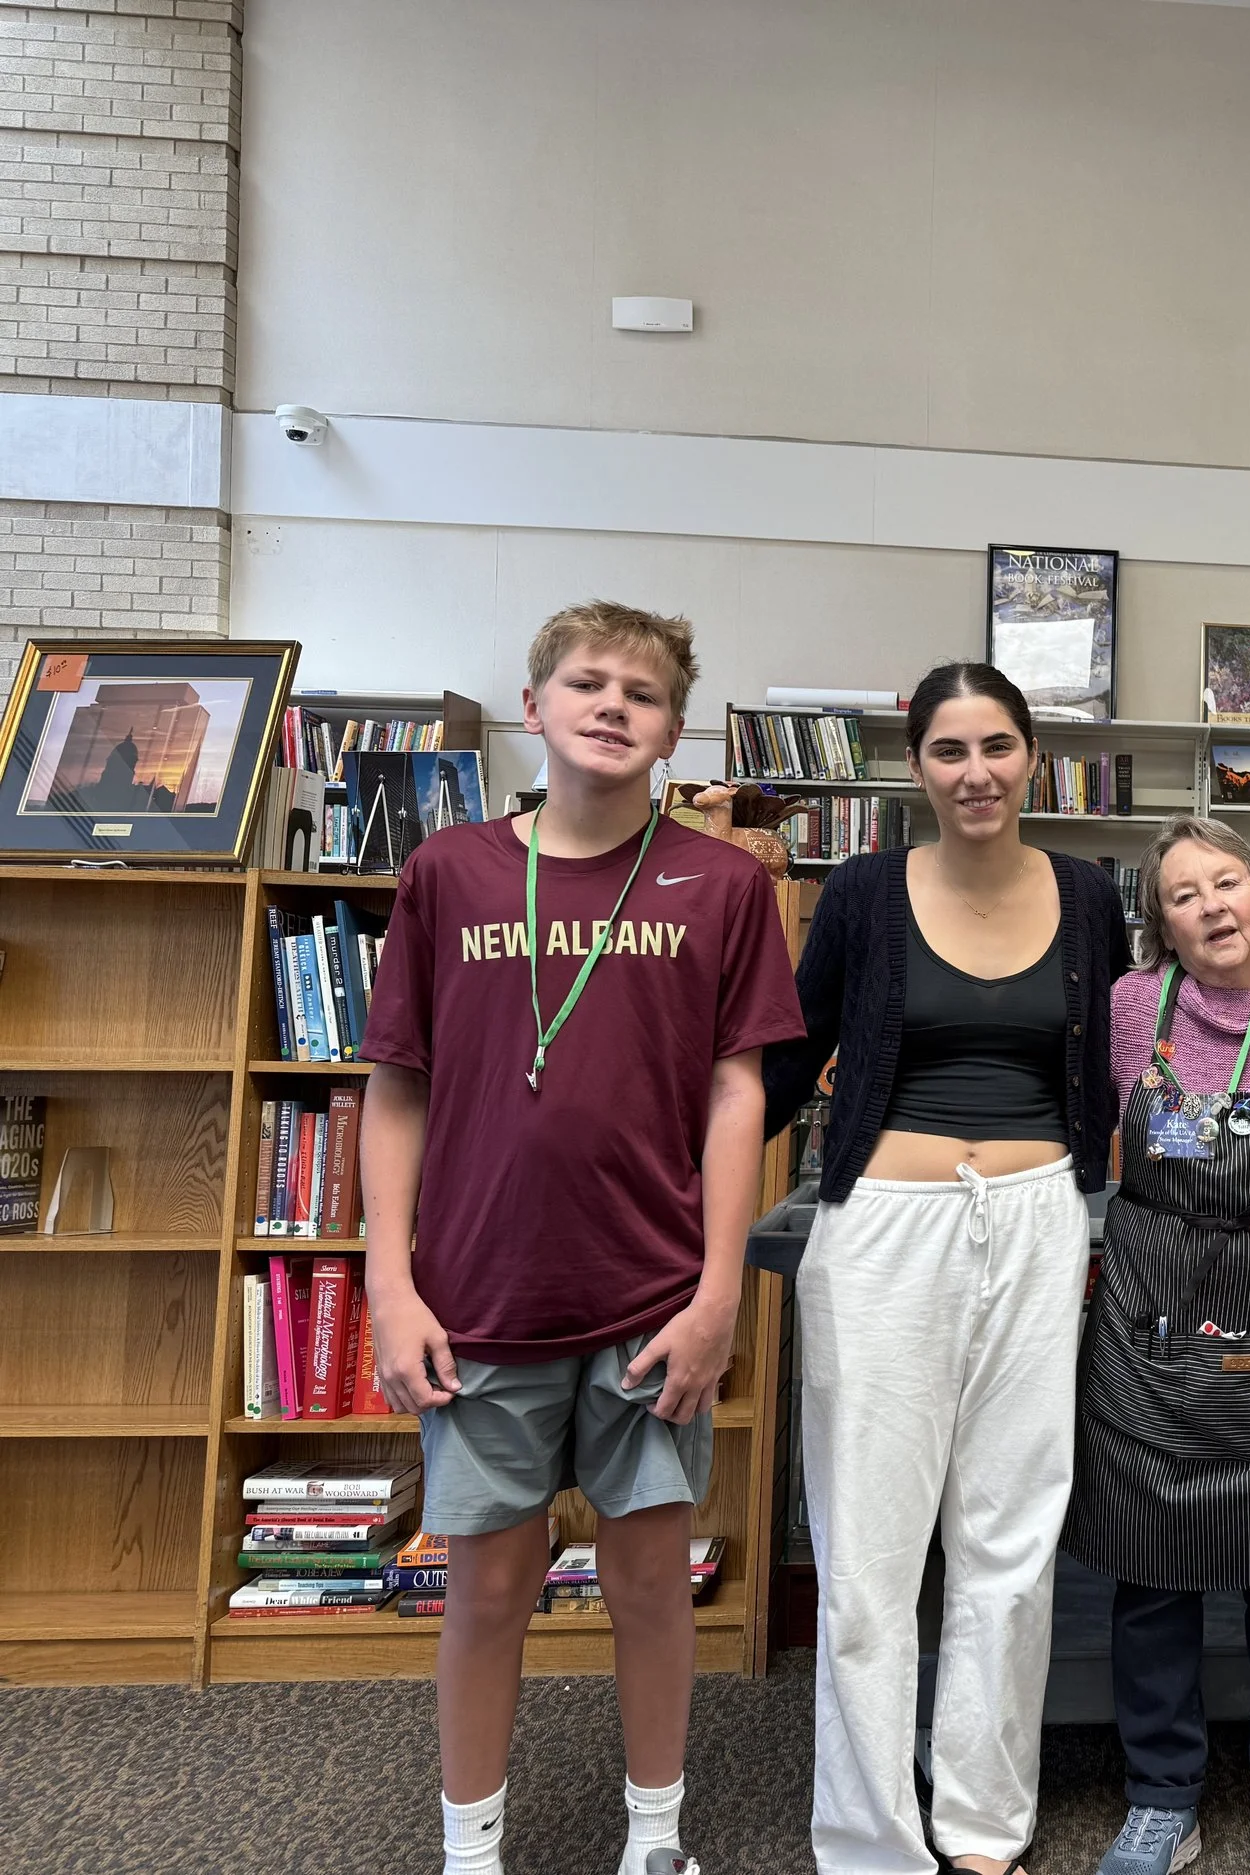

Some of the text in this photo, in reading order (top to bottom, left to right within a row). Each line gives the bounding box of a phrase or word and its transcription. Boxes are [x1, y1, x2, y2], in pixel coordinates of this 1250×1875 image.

[1009, 554, 1099, 573] NATIONAL
[1008, 573, 1099, 587] BOOK FESTIVAL
[268, 908, 278, 929] REEF
[462, 920, 687, 962] NEW ALBANY
[298, 944, 307, 971] GLEICK
[329, 936, 343, 985] murder 2
[5, 1096, 35, 1121] THE
[1167, 1120, 1187, 1129] Kate
[275, 1106, 290, 1188] TALKING TO ROBOTS
[332, 1183, 340, 1195] 16th
[12, 1201, 39, 1220] ROSS
[258, 1191, 268, 1217] TRIA
[329, 1195, 339, 1218] Edition
[314, 1280, 339, 1381] Medical Microbiology
[360, 1336, 375, 1380] DICTIONARY
[420, 1553, 448, 1563] IDIO
[326, 1568, 344, 1577] JEW
[265, 1596, 288, 1605] Dear
[291, 1595, 318, 1604] White
[321, 1594, 353, 1604] Friend
[416, 1600, 444, 1614] GLENN
